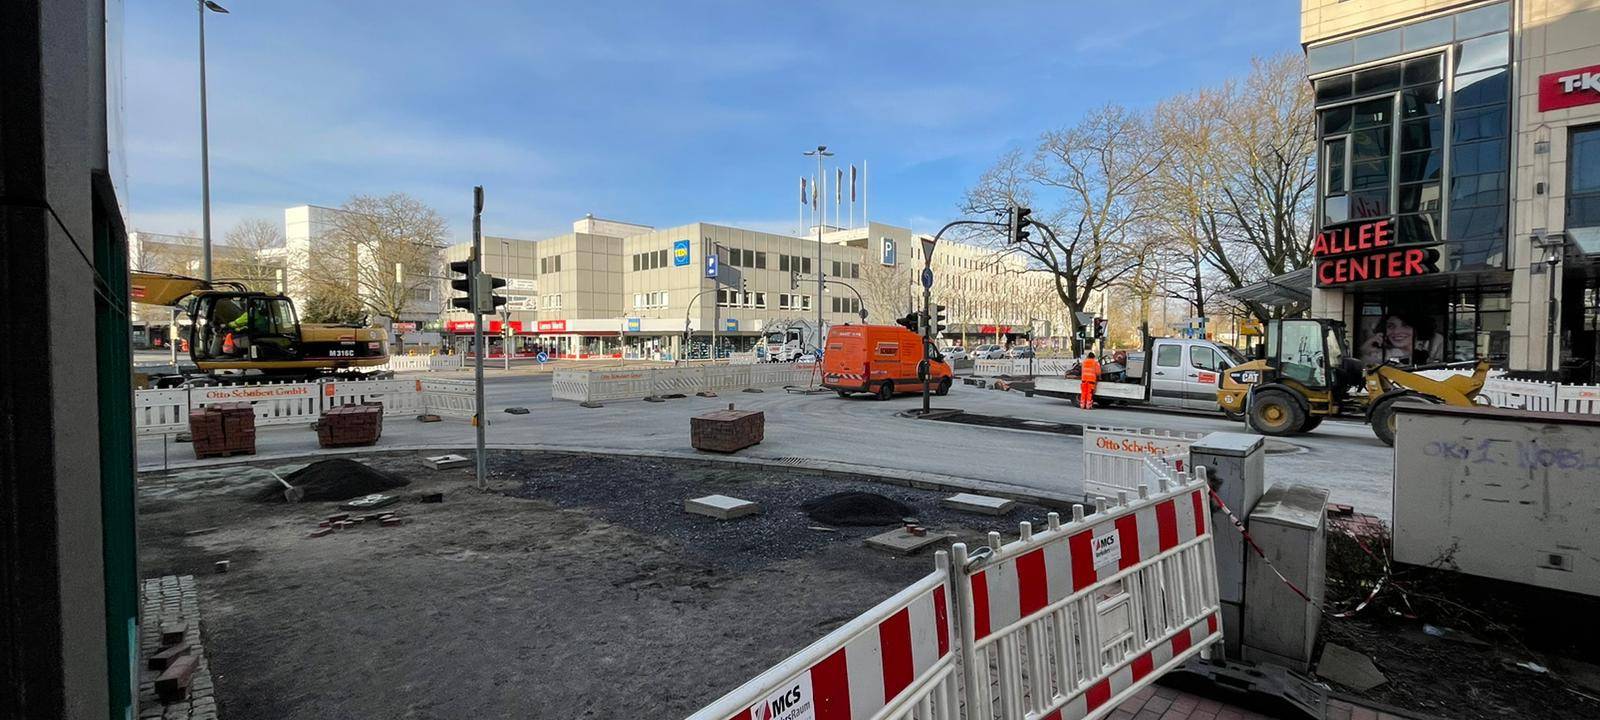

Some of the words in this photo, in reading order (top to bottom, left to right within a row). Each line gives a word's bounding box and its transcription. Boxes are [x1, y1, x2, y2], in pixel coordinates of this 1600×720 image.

[1313, 220, 1389, 256] ALLEE
[885, 241, 893, 257] P
[709, 257, 715, 268] P
[1319, 248, 1424, 286] CENTER
[1242, 372, 1259, 383] CAT
[206, 390, 231, 399] Otto
[232, 388, 273, 398] Schubert
[1096, 436, 1120, 451] Otto
[1100, 534, 1115, 549] MCS
[772, 685, 801, 718] MCS
